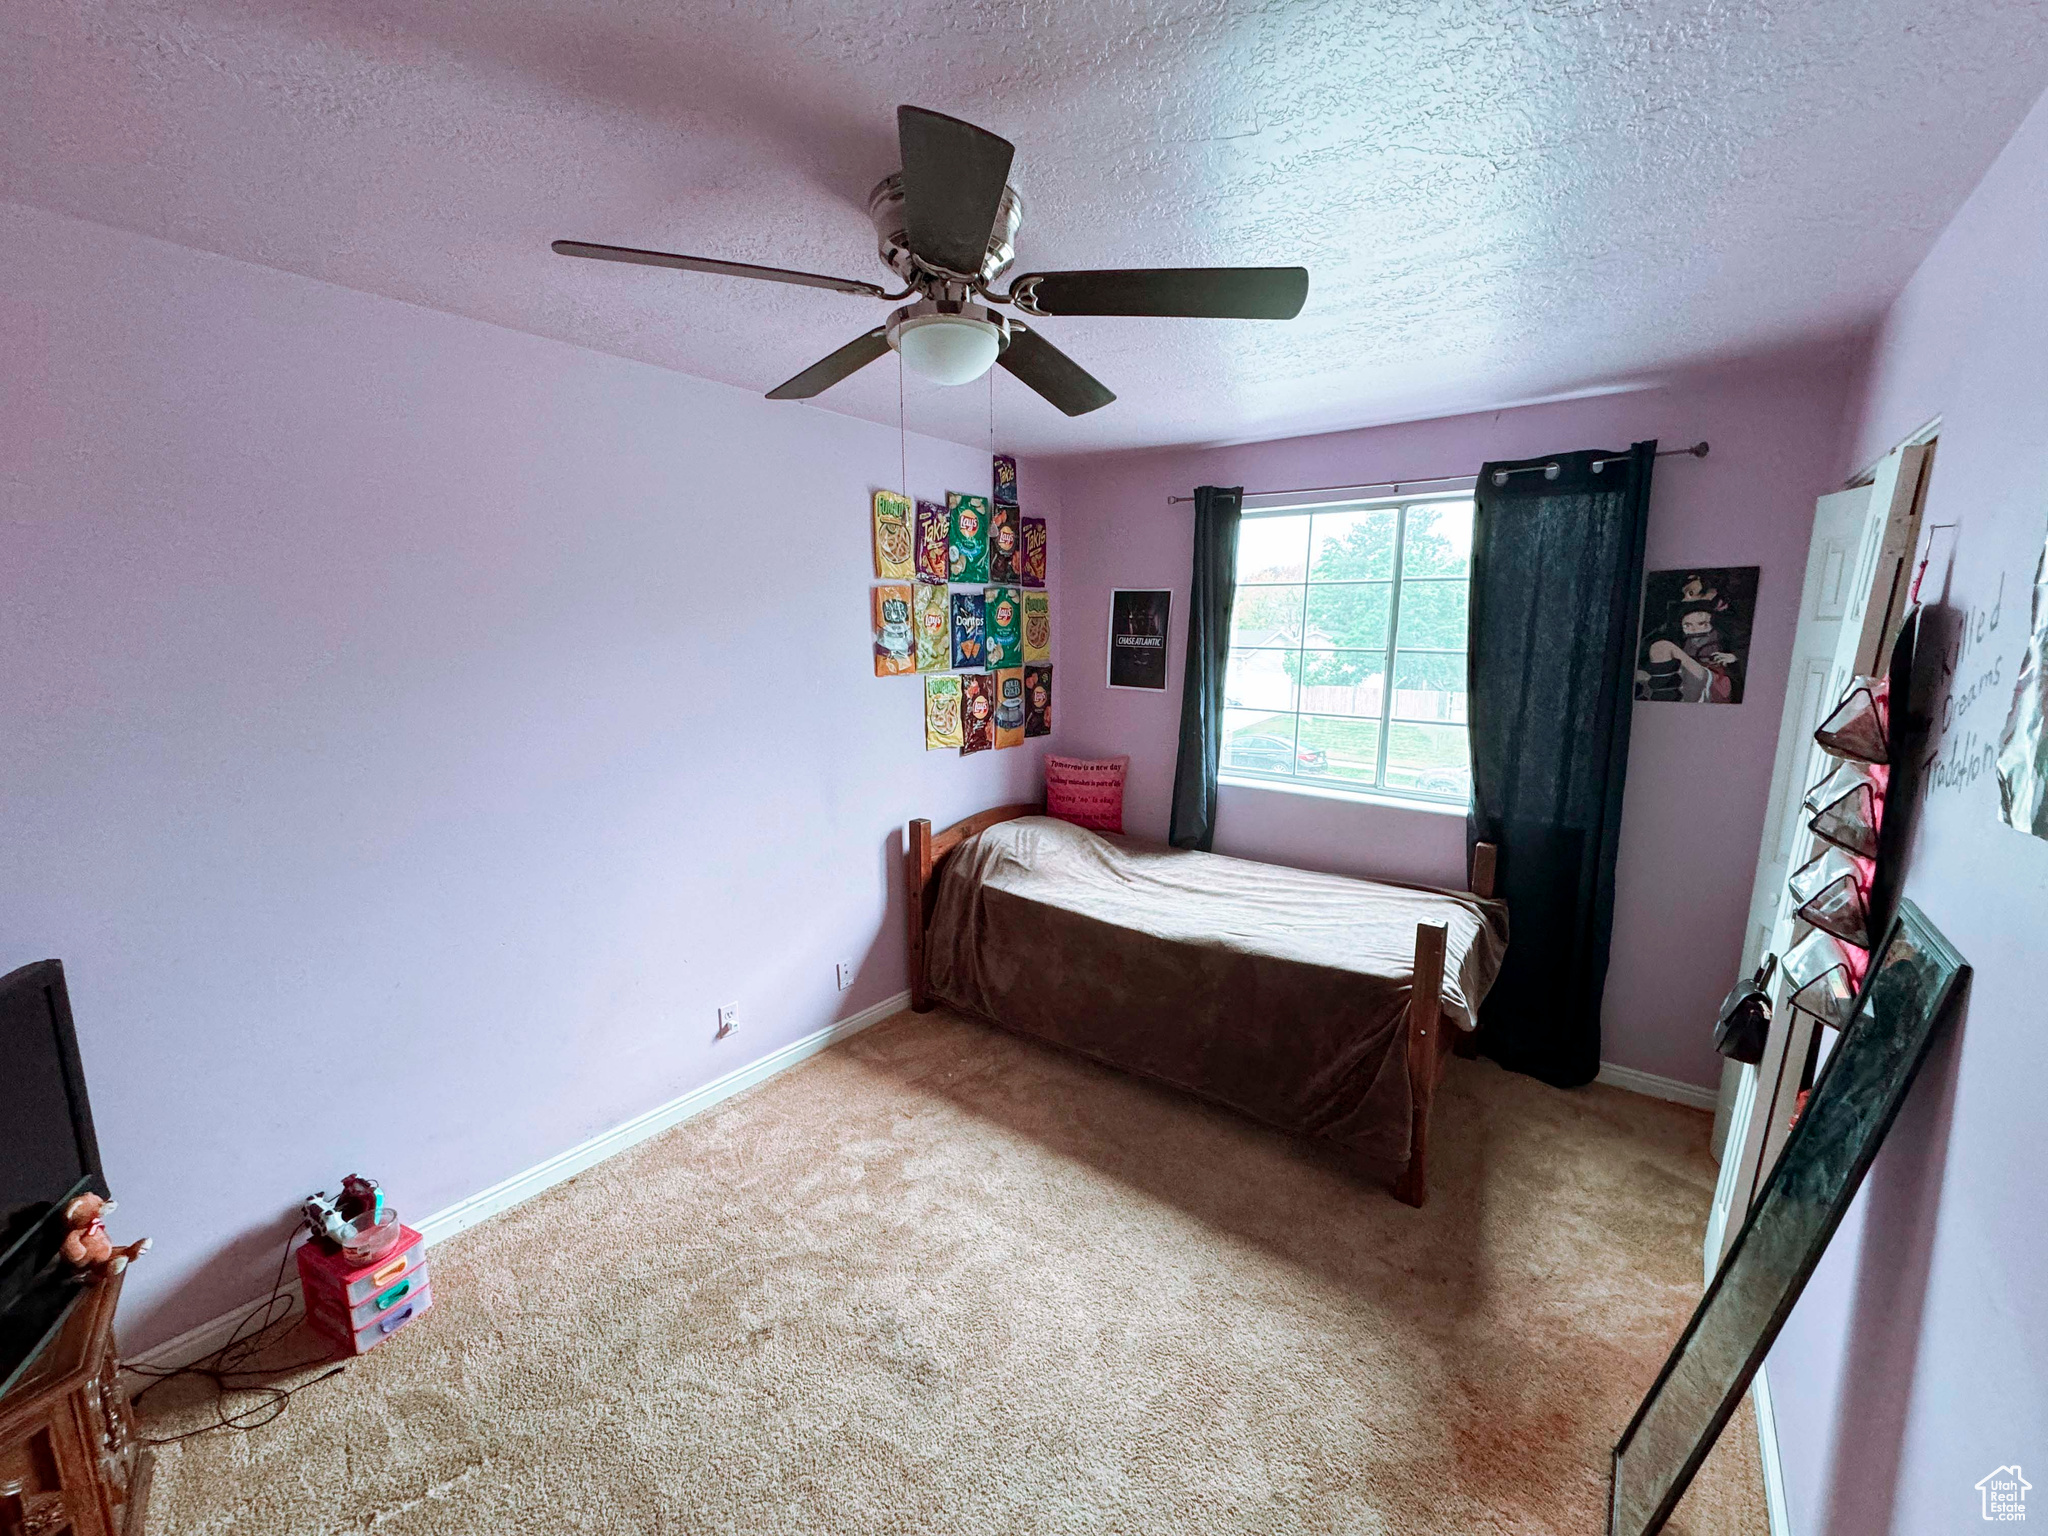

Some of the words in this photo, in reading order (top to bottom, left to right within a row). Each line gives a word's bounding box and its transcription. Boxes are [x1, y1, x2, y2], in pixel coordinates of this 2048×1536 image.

[922, 518, 950, 547] Takis
[1025, 528, 1047, 555] Takis
[956, 615, 984, 627] Doritos
[1118, 636, 1135, 645] CHASE
[1134, 637, 1162, 646] ATLANTIC
[1942, 655, 2002, 734] Dreams
[1051, 760, 1082, 771] Tomorrow
[1110, 763, 1122, 772] day
